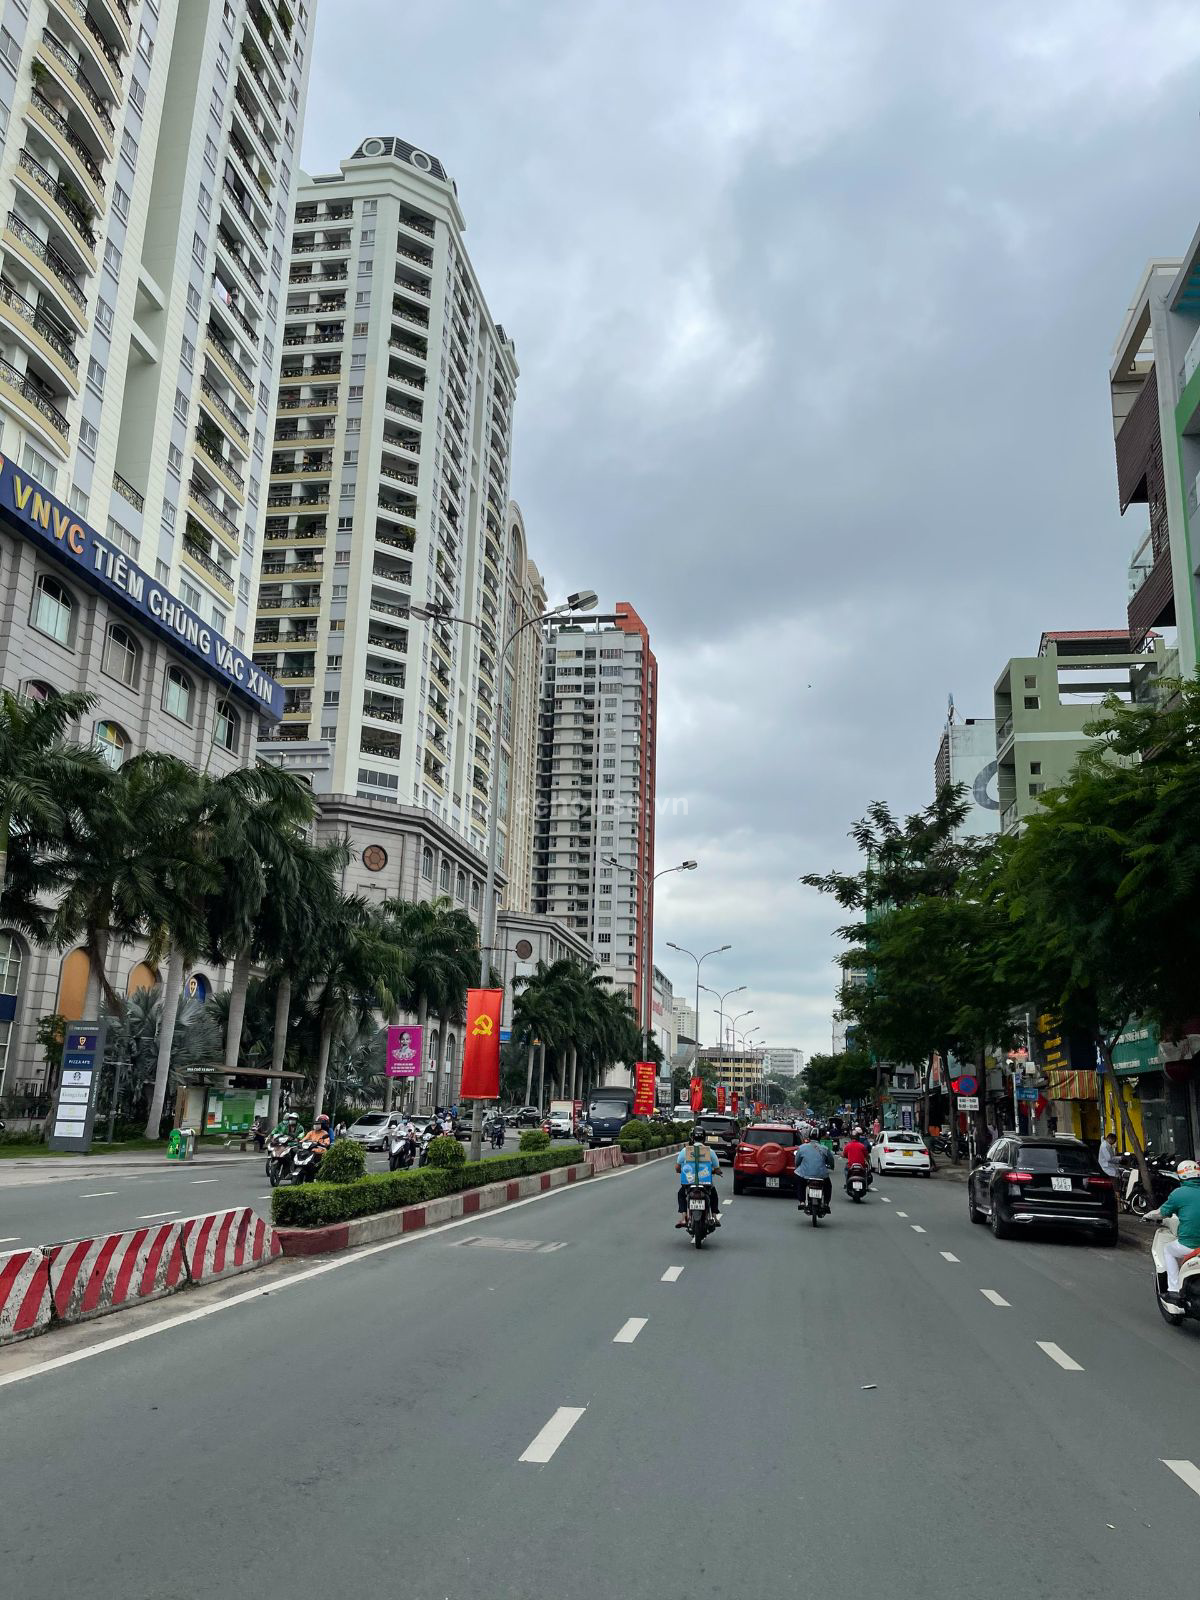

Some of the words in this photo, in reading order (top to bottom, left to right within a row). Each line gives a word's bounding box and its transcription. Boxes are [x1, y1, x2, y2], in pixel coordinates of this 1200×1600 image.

[13, 475, 86, 554] VNVC
[93, 540, 144, 603] TIÊM
[148, 589, 210, 654] CHỦNG
[247, 668, 272, 704] XIN
